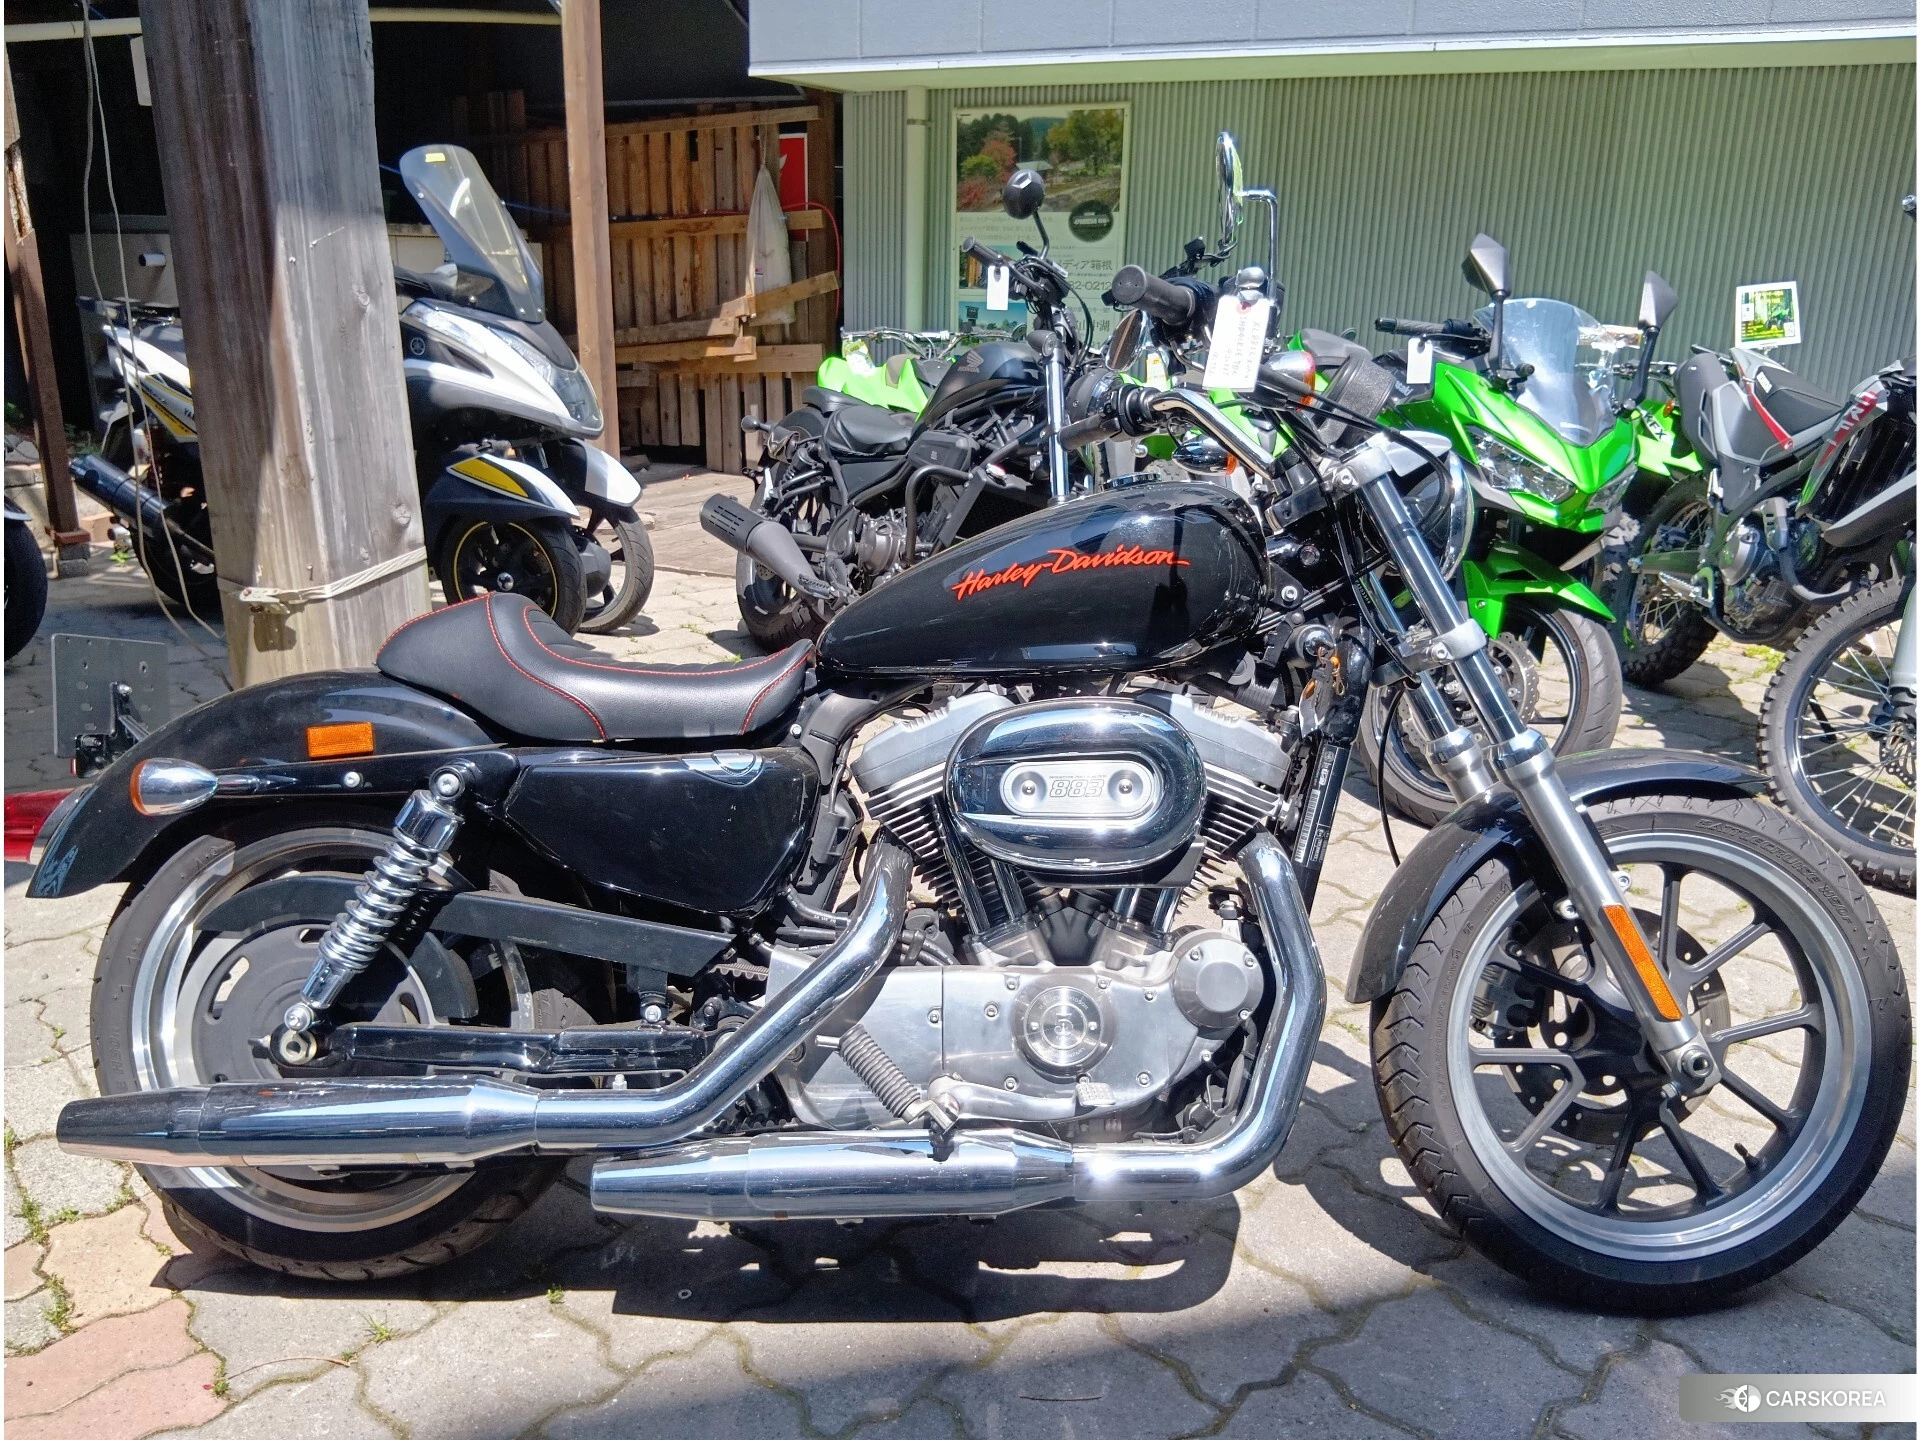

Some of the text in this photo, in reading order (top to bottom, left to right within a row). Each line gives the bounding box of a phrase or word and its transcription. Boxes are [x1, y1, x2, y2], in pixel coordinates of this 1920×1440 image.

[1061, 259, 1113, 271] ディア箱根
[1643, 412, 1668, 440] KFX
[952, 544, 1191, 601] Harley-Davidson
[1049, 778, 1105, 798] 883
[1695, 818, 1821, 885] BATTLECRUISE
